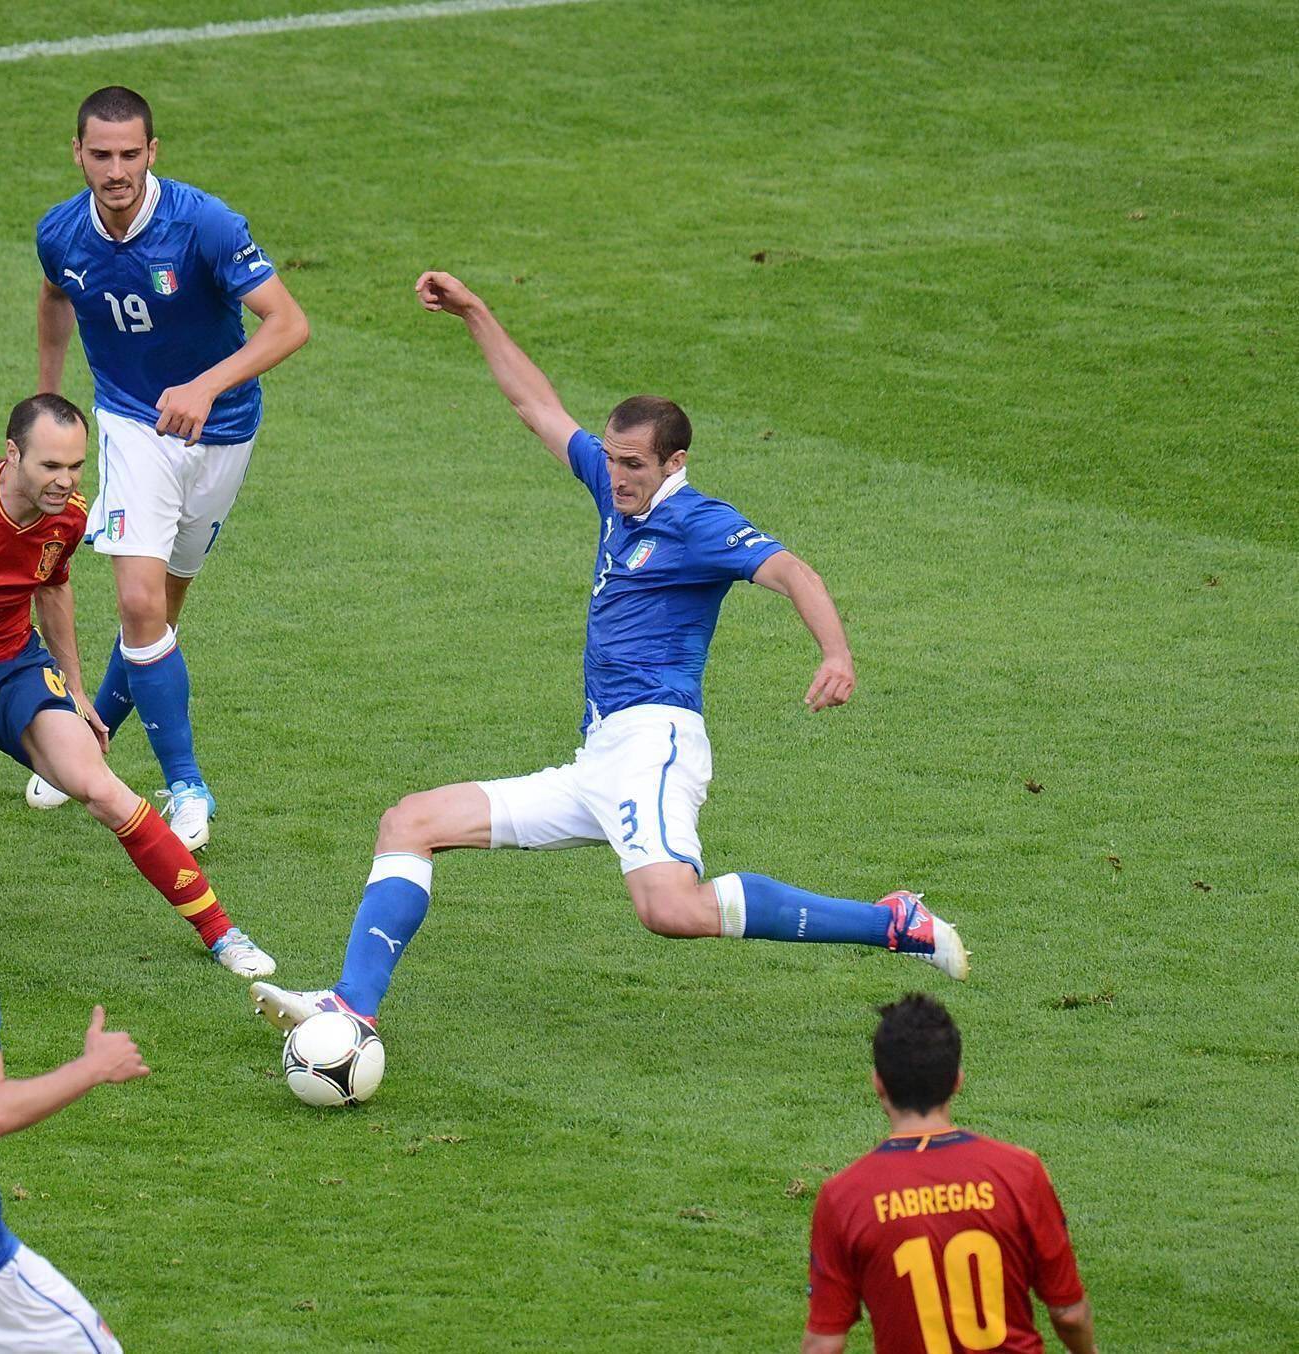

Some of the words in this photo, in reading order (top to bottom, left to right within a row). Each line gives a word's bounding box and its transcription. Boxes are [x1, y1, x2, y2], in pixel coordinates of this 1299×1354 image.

[104, 292, 153, 332] 19
[205, 521, 221, 554] 1
[43, 667, 67, 697] 6
[619, 799, 638, 842] 3
[174, 870, 199, 889] adidas
[798, 908, 807, 936] ITALIA
[874, 1181, 995, 1223] FABREGAS
[893, 1229, 1007, 1354] 10
